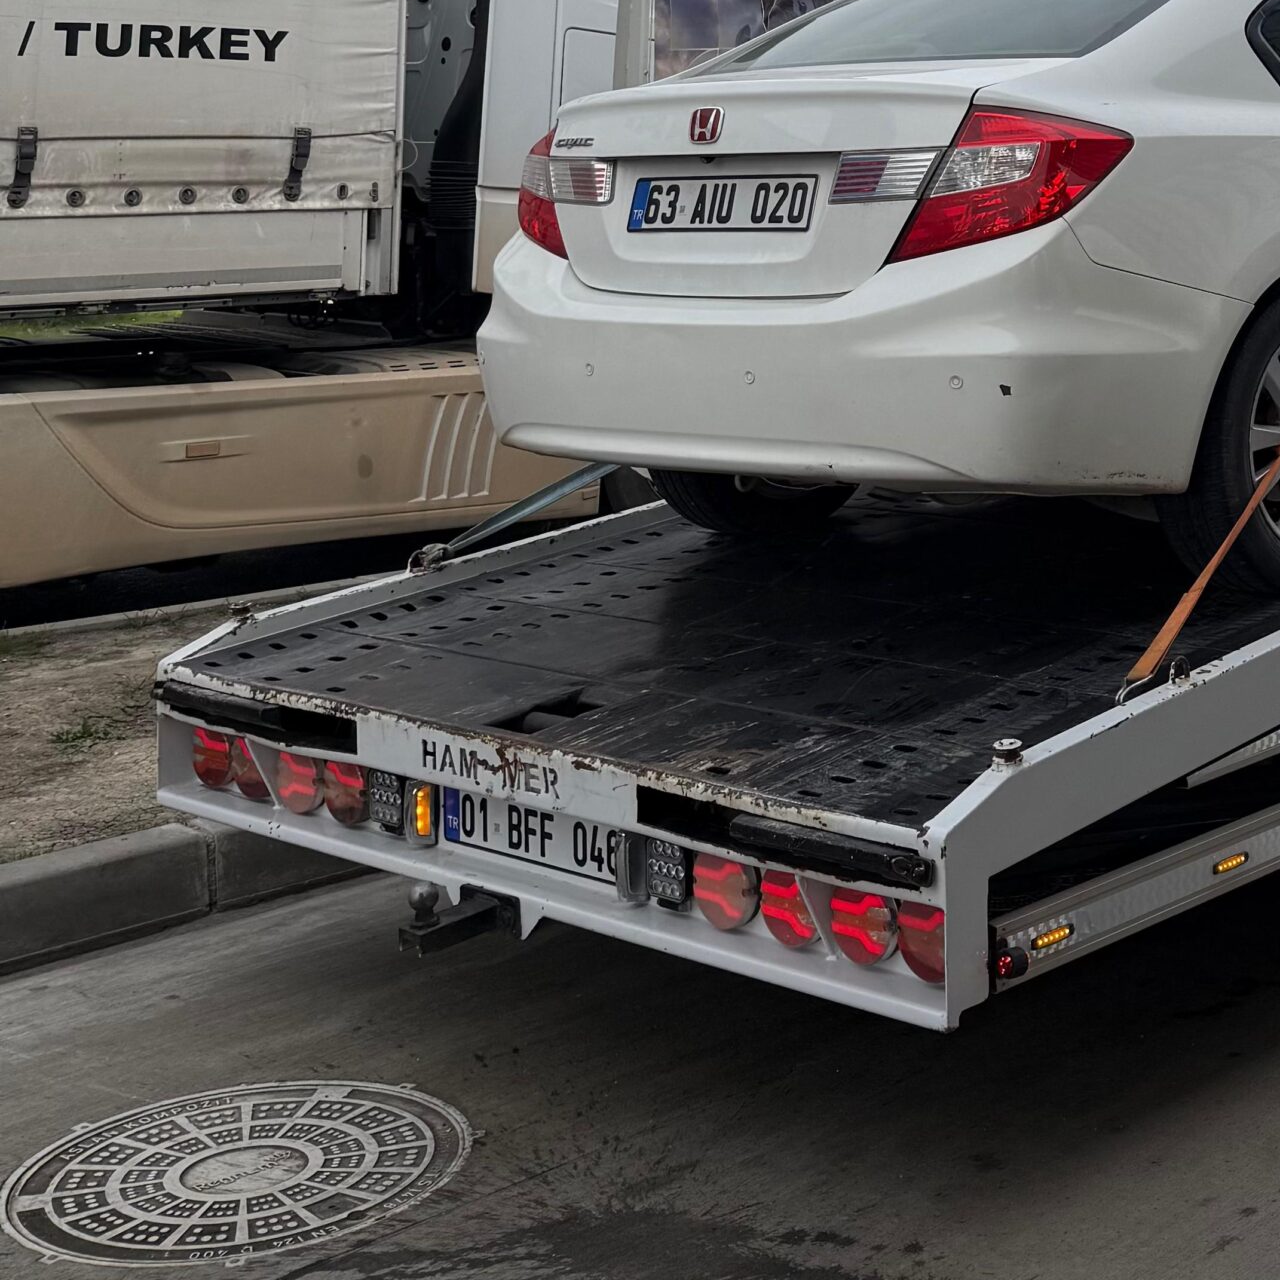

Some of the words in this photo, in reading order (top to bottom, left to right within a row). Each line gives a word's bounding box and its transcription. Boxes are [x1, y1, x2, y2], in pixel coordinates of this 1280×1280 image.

[54, 22, 290, 62] TURKEY
[633, 209, 644, 219] TR
[643, 184, 681, 224] 63
[690, 182, 737, 224] AIU
[750, 182, 809, 224] 020
[447, 815, 459, 830] TR
[461, 793, 488, 843] 01
[507, 803, 555, 858] BFF
[60, 1130, 119, 1161] ASLAN
[272, 1235, 304, 1248] 124
[311, 1225, 340, 1238] EN
[189, 1250, 228, 1260] 400
